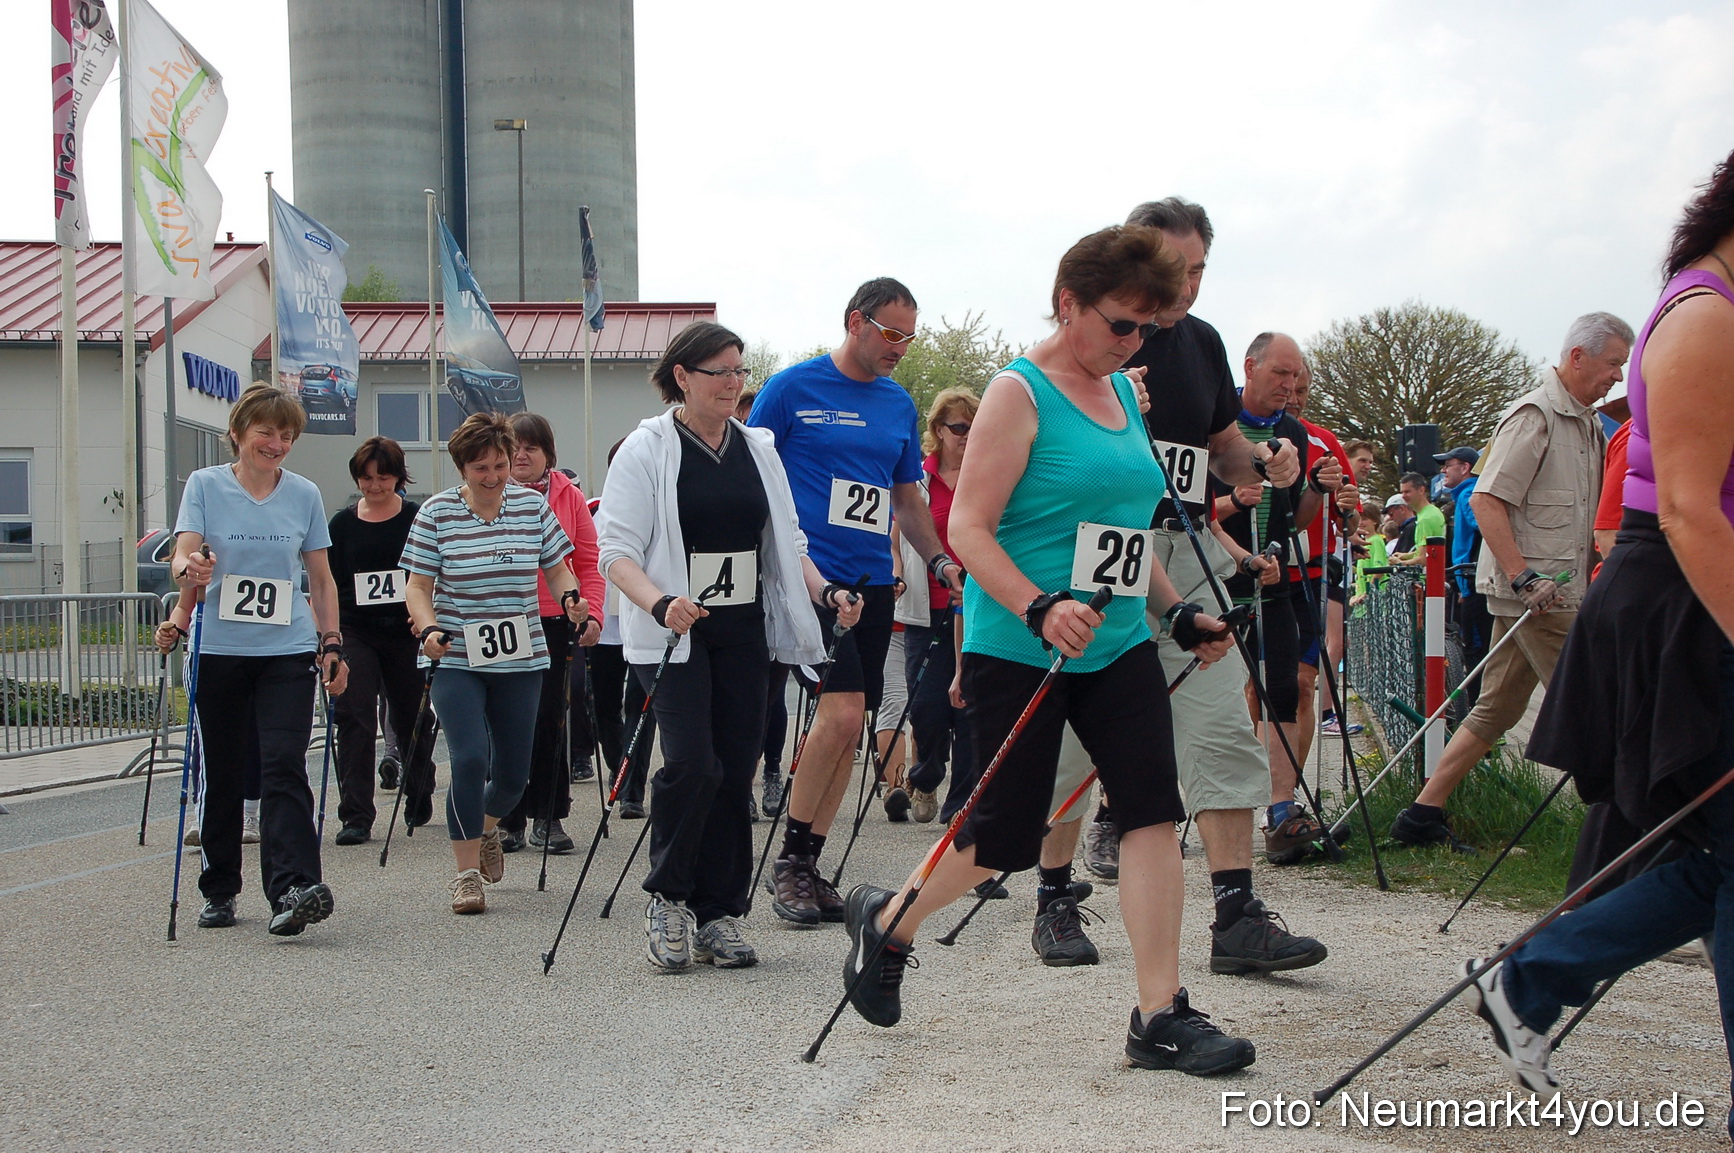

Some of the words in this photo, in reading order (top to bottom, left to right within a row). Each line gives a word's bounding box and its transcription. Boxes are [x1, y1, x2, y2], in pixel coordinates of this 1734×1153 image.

[80, 59, 97, 86] mit
[91, 24, 115, 57] Ide
[306, 233, 331, 249] VOLVO
[183, 352, 240, 402] VOLVO
[309, 412, 347, 422] VOLVOCARS.DE
[1164, 446, 1196, 494] 19
[844, 483, 881, 526] 22
[228, 534, 247, 543] JOY
[268, 534, 291, 543] 1977
[1092, 529, 1146, 588] 28
[367, 573, 396, 600] 24
[714, 556, 735, 598] 4
[234, 579, 278, 619] 29
[478, 620, 518, 660] 30
